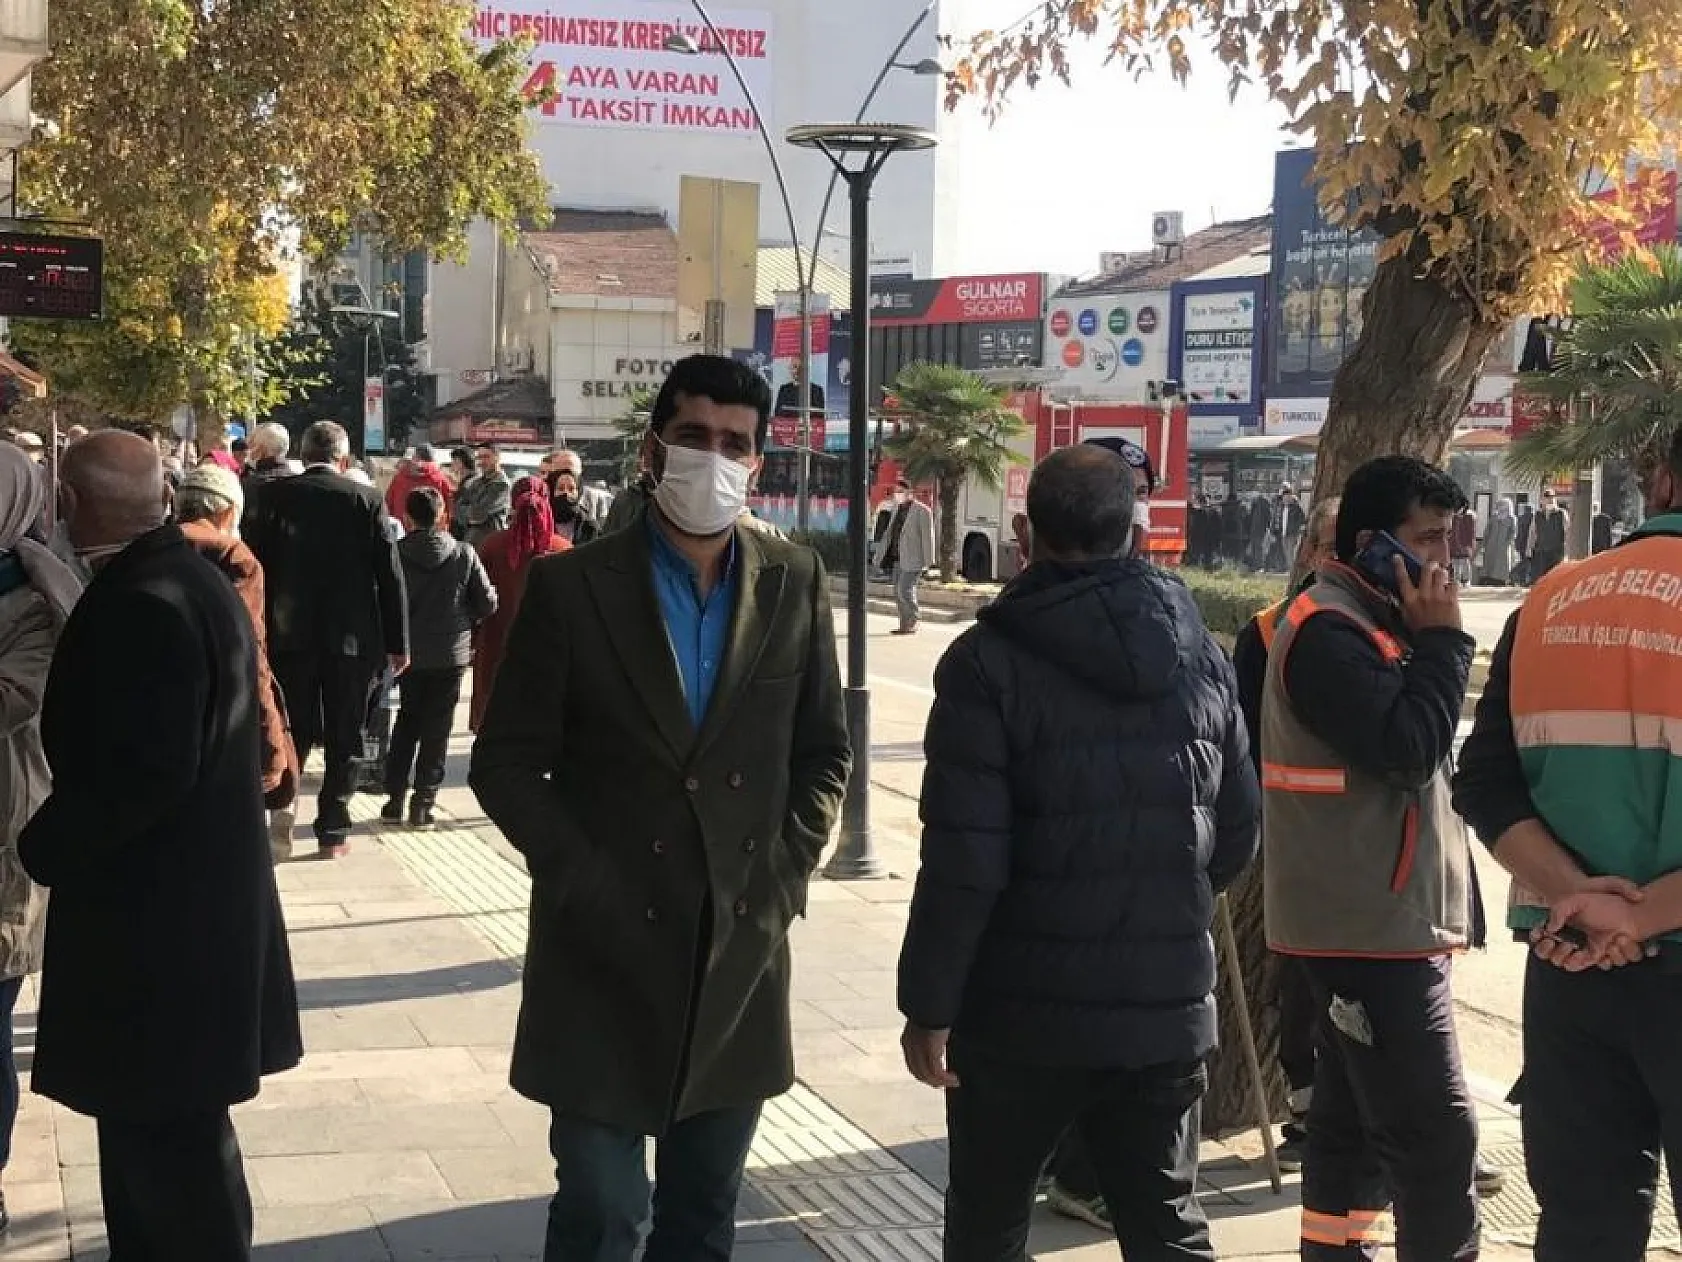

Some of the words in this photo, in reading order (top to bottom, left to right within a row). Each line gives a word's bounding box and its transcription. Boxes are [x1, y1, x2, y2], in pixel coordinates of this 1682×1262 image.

[566, 65, 620, 90] AYA
[625, 68, 719, 96] VARAN
[566, 96, 657, 124] TAKSİT
[615, 358, 673, 375] FOTO
[1546, 567, 1618, 621] ELAZIĞ
[1616, 569, 1682, 610] BELEDİ
